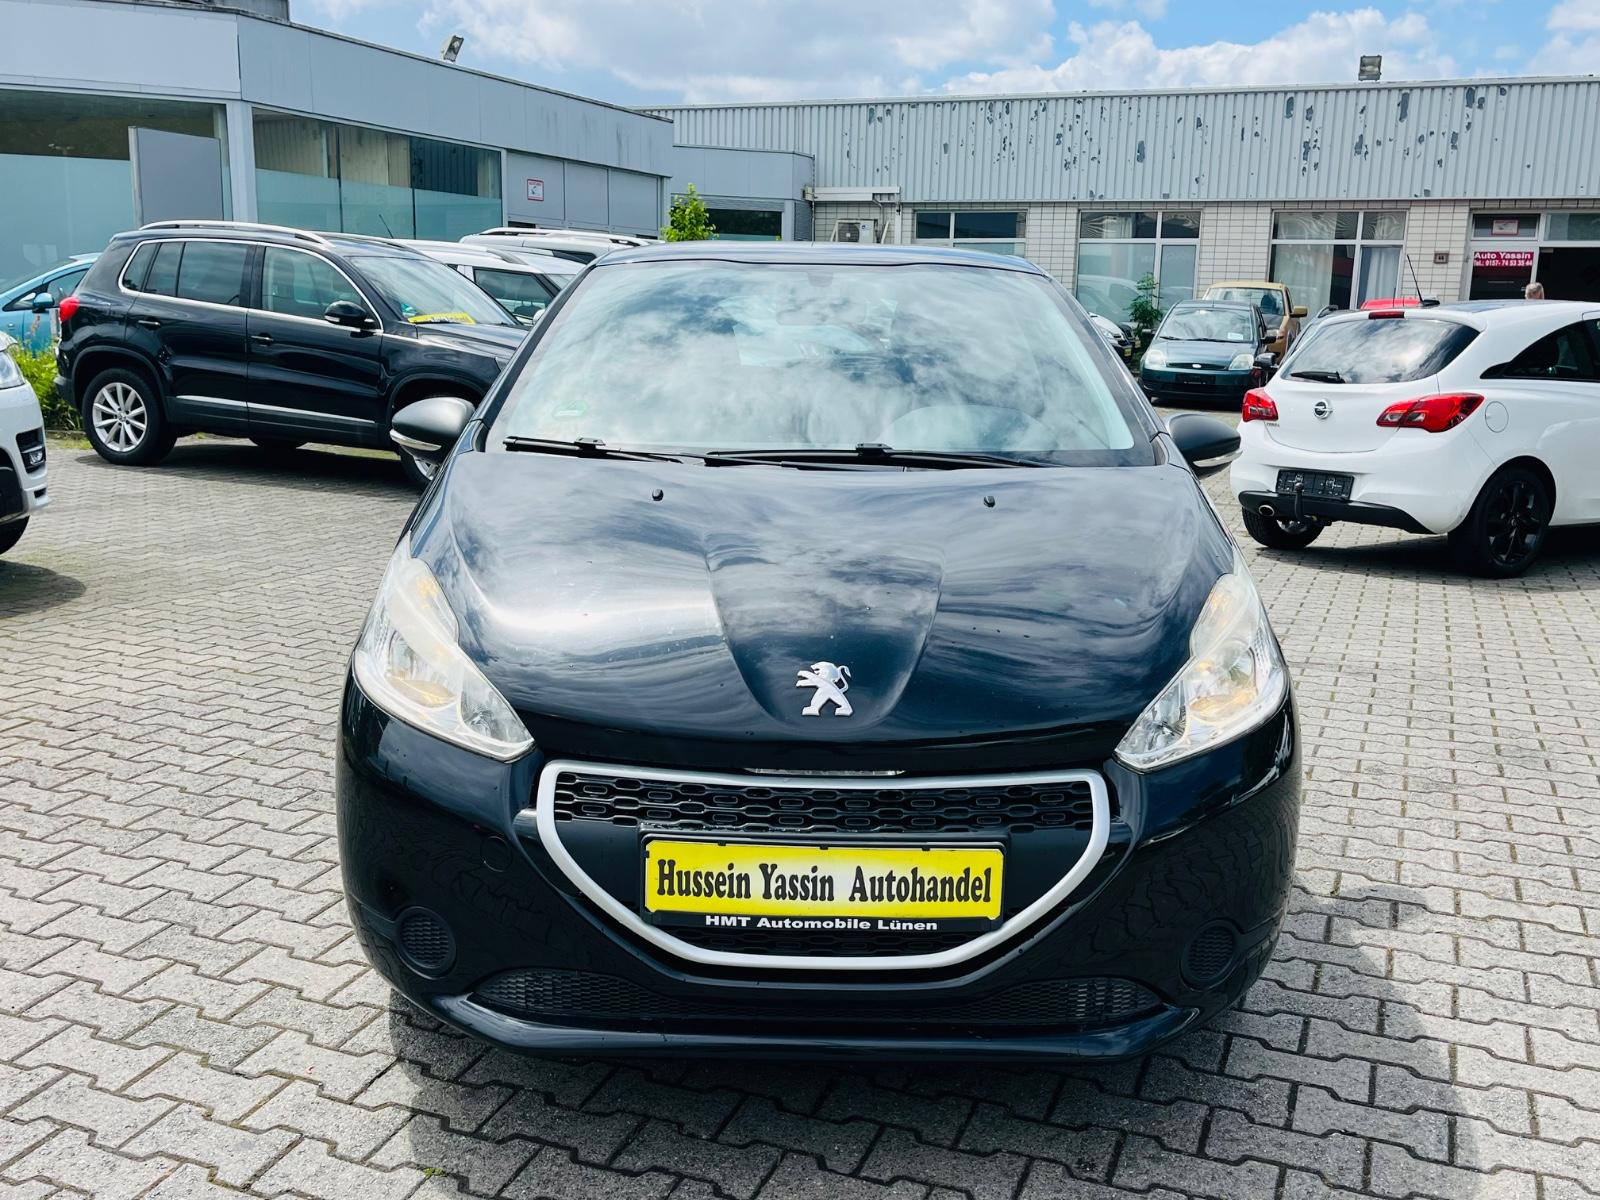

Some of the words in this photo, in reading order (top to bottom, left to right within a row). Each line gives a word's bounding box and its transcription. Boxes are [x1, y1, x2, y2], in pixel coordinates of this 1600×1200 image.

[657, 859, 751, 899] Hussein
[759, 863, 834, 901] Yassin
[848, 865, 992, 902] Autohandel
[705, 915, 751, 927] HMT
[757, 917, 871, 930] Automobile
[877, 919, 938, 931] Lünen
